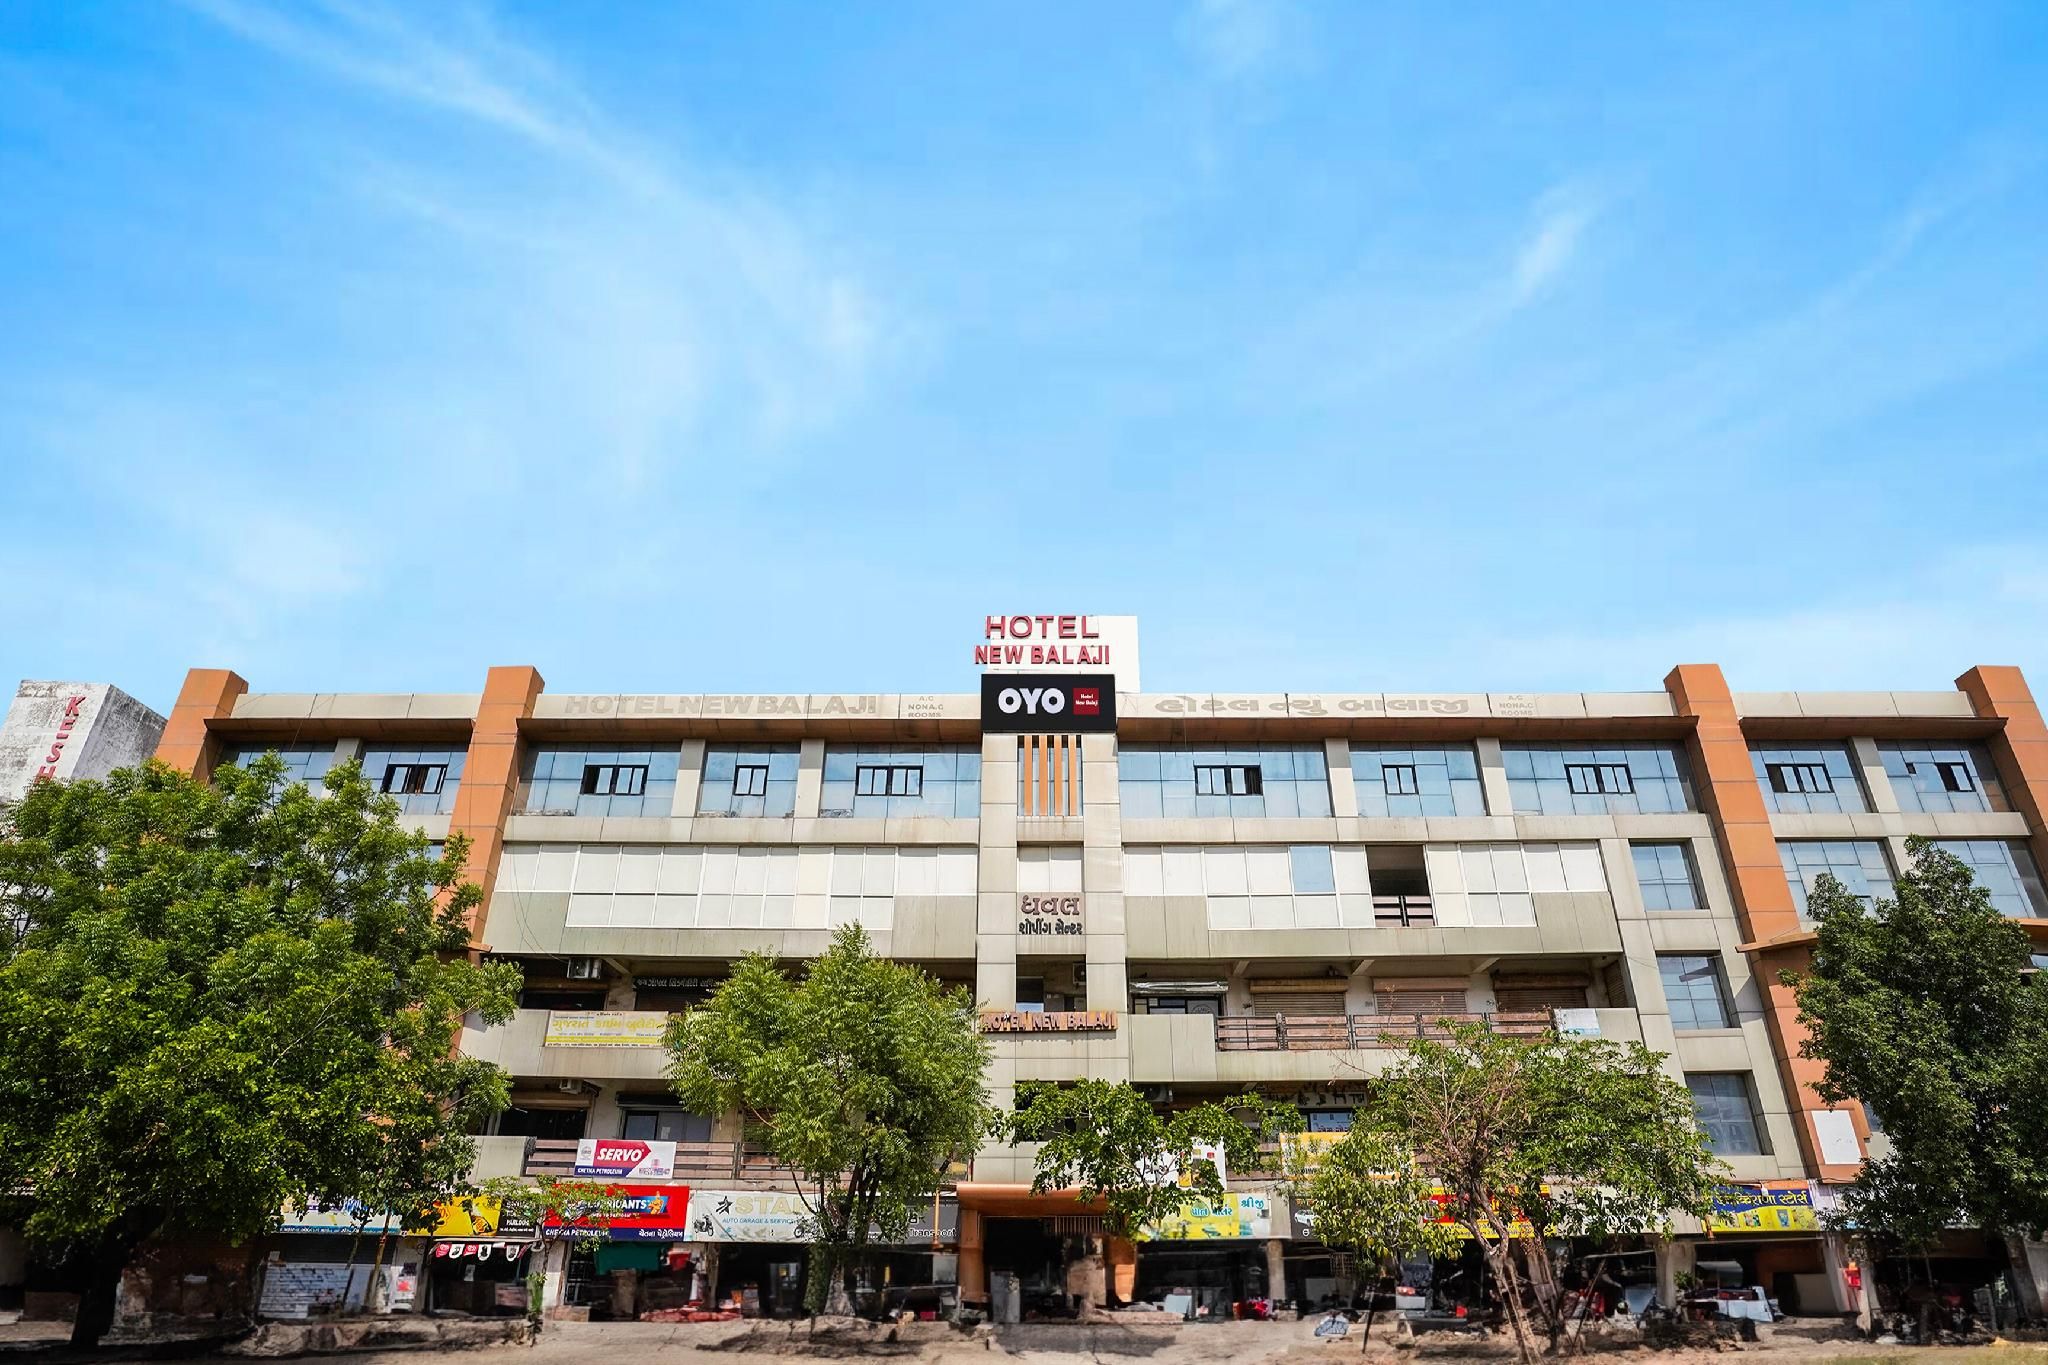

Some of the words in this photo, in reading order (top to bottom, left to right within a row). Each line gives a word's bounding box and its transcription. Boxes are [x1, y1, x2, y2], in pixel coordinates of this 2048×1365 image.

[986, 616, 1100, 639] HOTEL
[975, 645, 1024, 664] NEW
[1031, 645, 1110, 664] BALAJI
[564, 696, 674, 714] HOTEL
[678, 696, 752, 714] NEW
[757, 695, 877, 714] BALAJI
[998, 688, 1065, 714] OYO
[1021, 895, 1080, 915] ધવલ
[1032, 1014, 1061, 1029] NEW
[1067, 1013, 1116, 1029] BALAJI
[597, 1147, 642, 1162] SERVO
